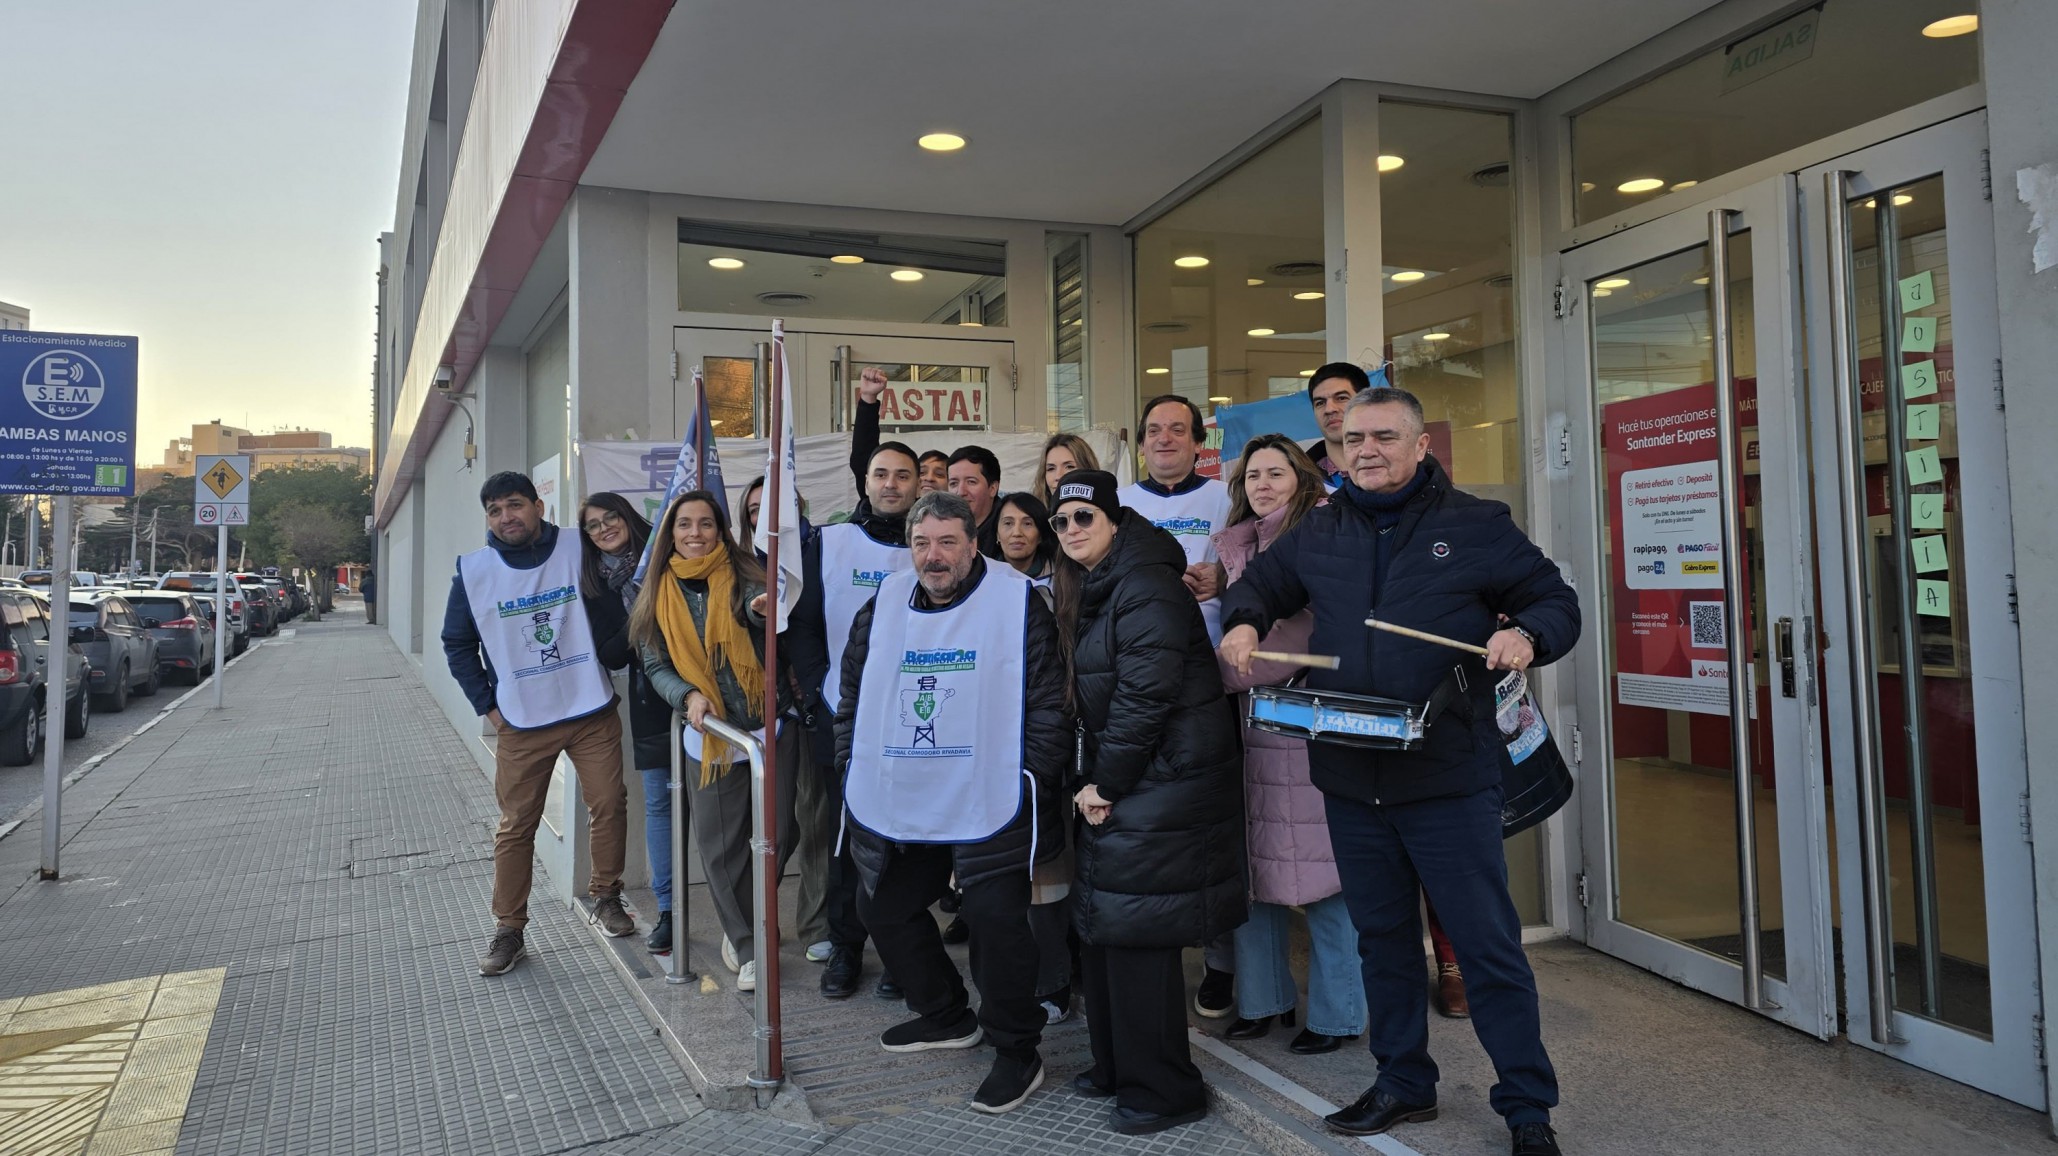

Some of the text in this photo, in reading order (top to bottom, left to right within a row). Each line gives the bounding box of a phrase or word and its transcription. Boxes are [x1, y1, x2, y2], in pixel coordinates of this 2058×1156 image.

[2, 334, 127, 348] Estacionamiento Medido
[37, 387, 90, 402] S.E.M
[855, 387, 982, 421] ASTA!
[1618, 419, 1639, 434] Hacé
[1640, 420, 1654, 431] tus
[1655, 409, 1709, 430] operaciones
[0, 427, 127, 443] AMBAS MANOS
[1627, 427, 1717, 450] Santander Express
[113, 468, 121, 484] 1
[1651, 478, 1674, 488] efectivo
[1686, 473, 1713, 484] Depositá
[1649, 496, 1658, 504] tus
[1659, 494, 1681, 505] tarjetas
[1681, 495, 1686, 503] y
[1686, 490, 1718, 502] préstamos
[202, 510, 215, 518] 20
[1633, 544, 1667, 554] rapipago
[1685, 544, 1703, 552] PAGO
